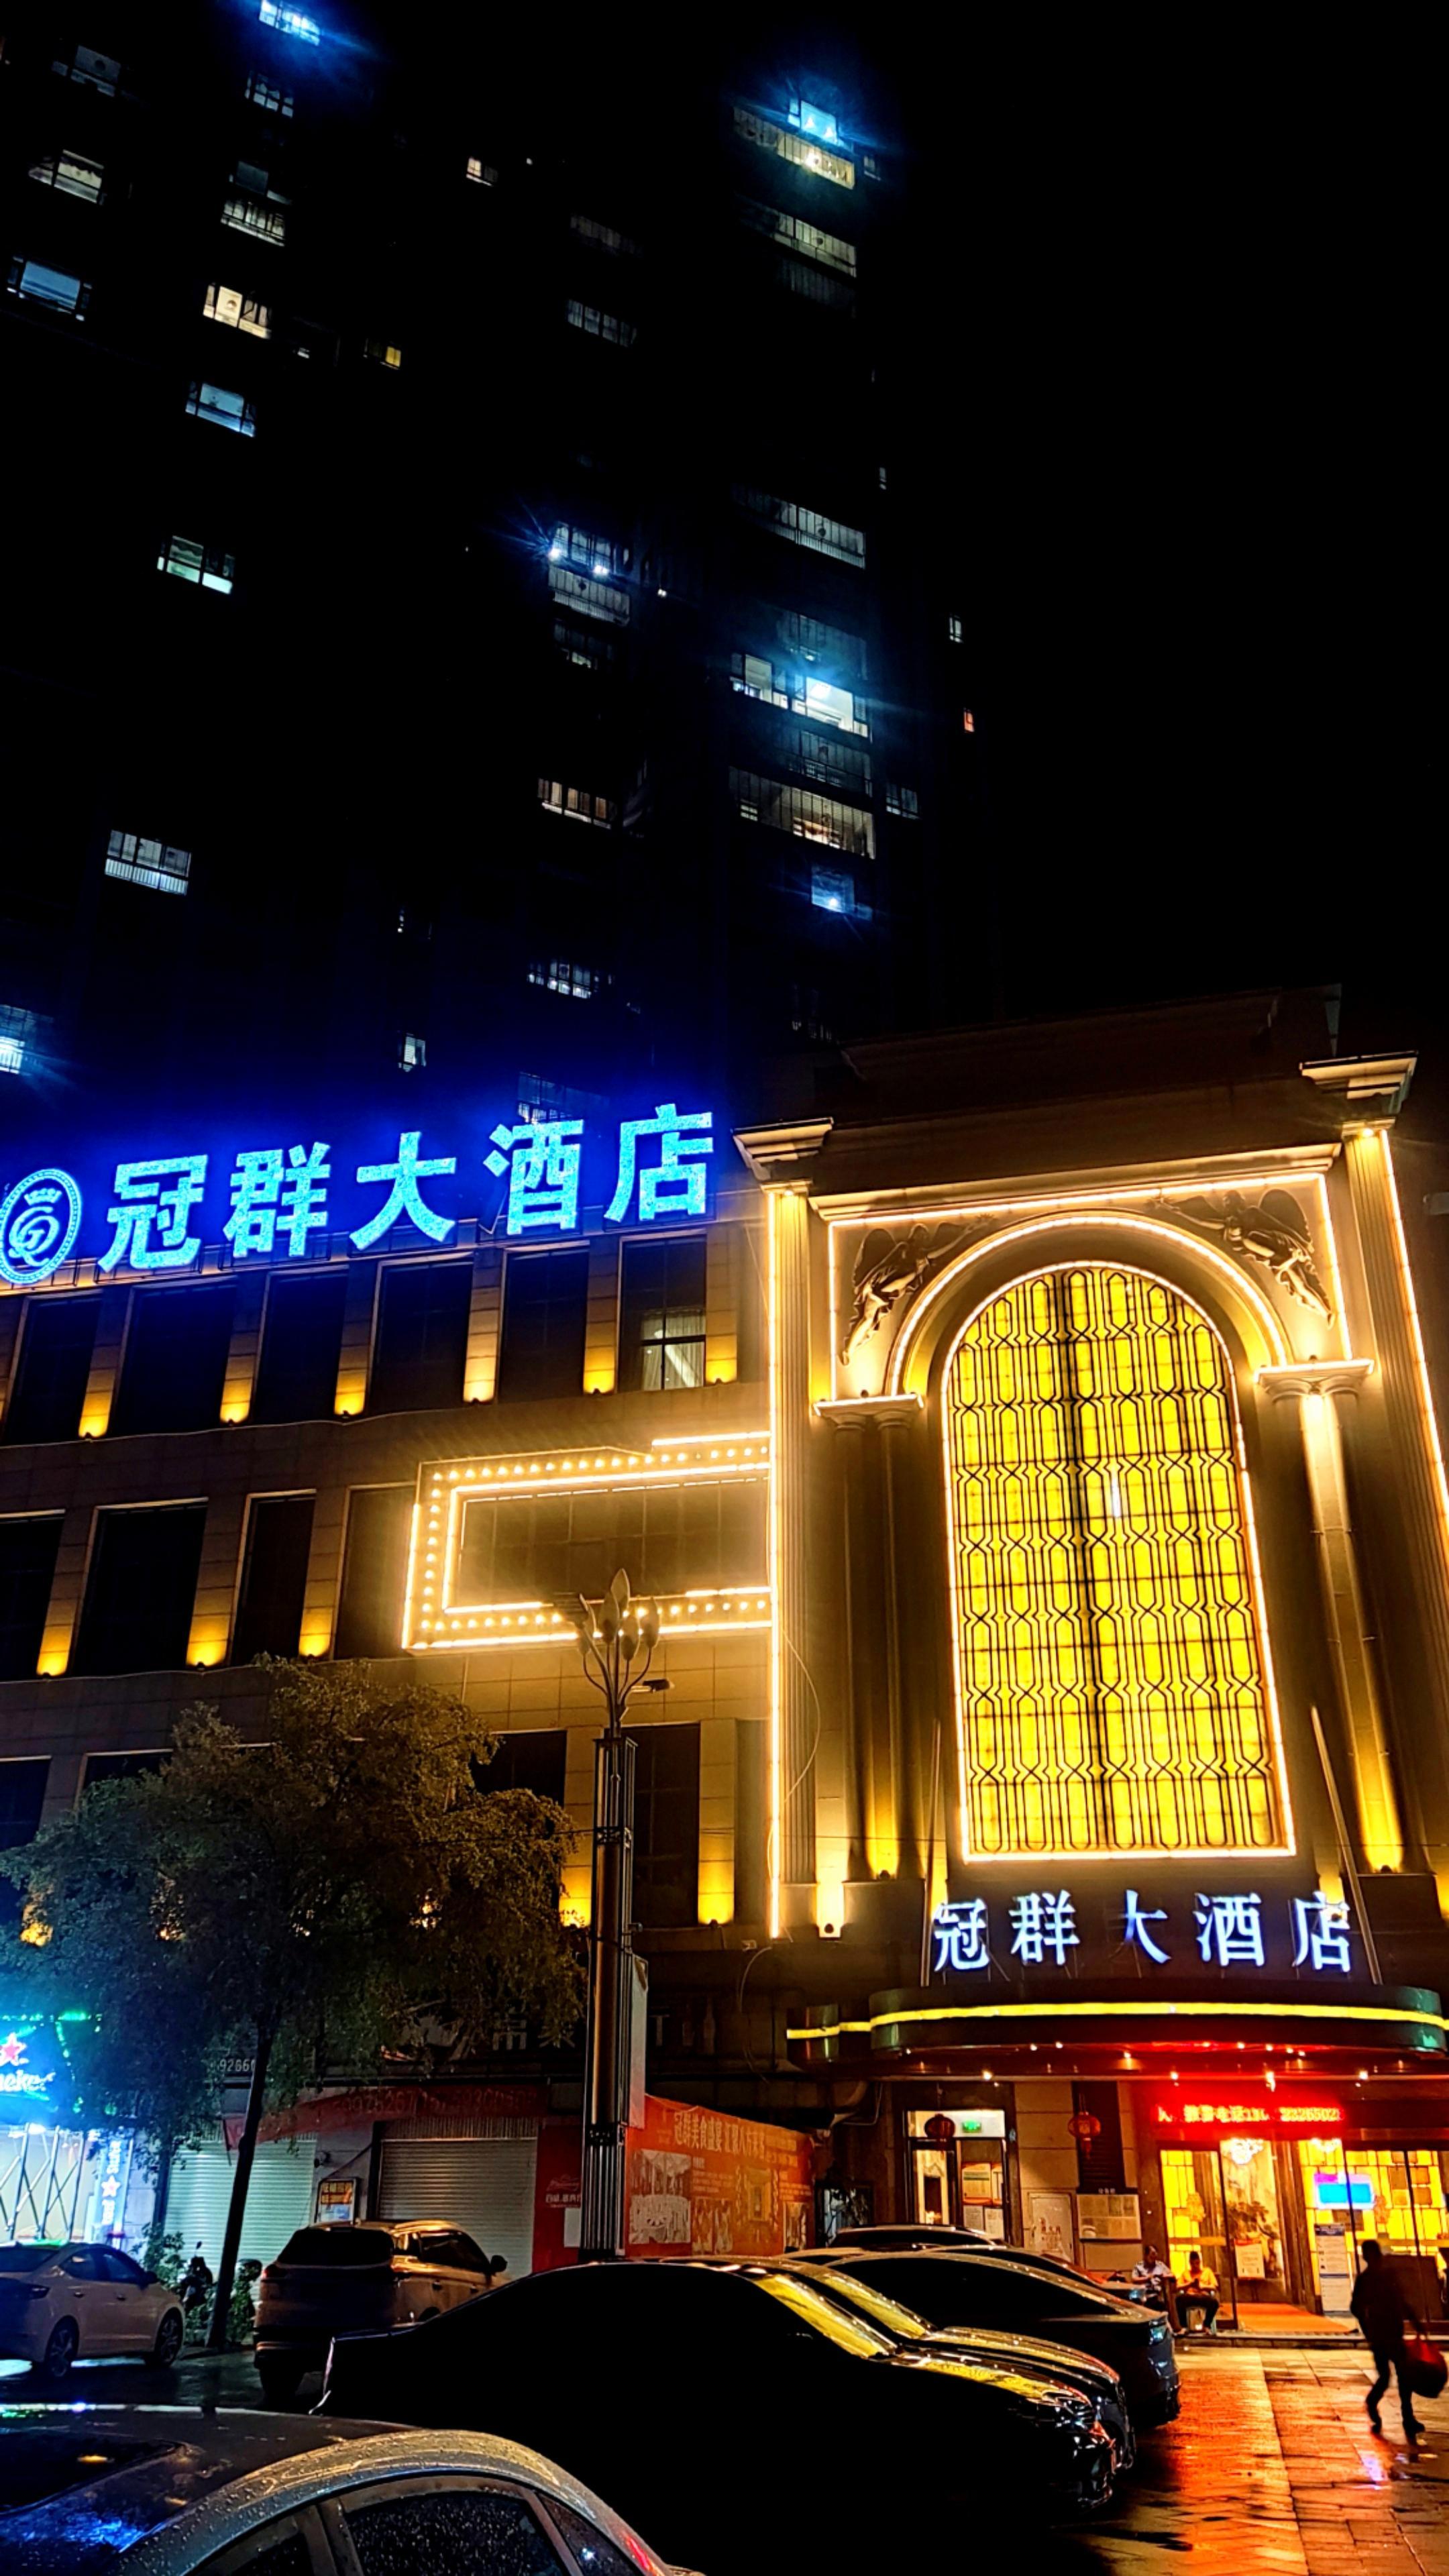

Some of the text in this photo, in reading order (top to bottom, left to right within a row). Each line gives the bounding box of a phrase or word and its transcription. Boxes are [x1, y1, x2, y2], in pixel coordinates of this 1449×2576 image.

[97, 1103, 714, 1272] 冠群大酒店
[933, 1888, 1352, 1972] 冠群大酒店
